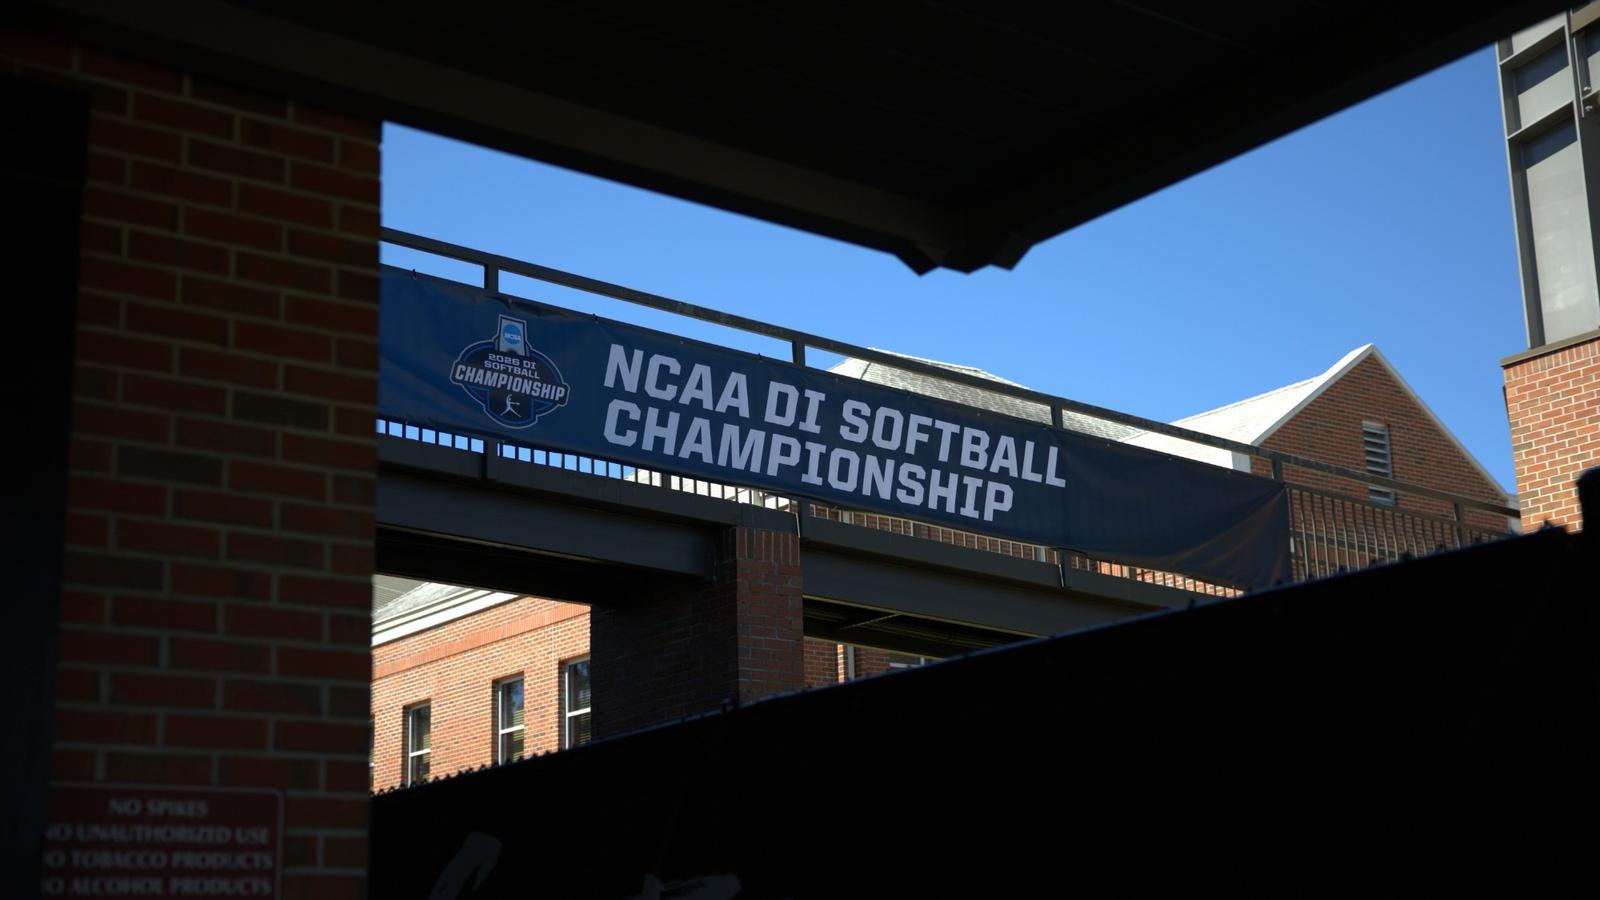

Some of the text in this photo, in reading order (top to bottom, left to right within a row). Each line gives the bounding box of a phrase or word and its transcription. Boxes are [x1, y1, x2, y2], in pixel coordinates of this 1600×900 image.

[484, 360, 540, 379] SOFTBALL
[489, 353, 537, 370] 2026 DI
[455, 365, 566, 401] CHAMPIONSHIP
[603, 343, 1066, 488] NCAA DI SOFTBALL
[603, 399, 1014, 521] CHAMPIONSHIP
[108, 798, 208, 817] NO SPIKES
[76, 824, 231, 843] UNAUTHORIZED
[235, 827, 268, 845] USE
[70, 851, 168, 869] TOBACCO
[170, 852, 273, 870] PRODUCTS
[69, 876, 163, 895] ALCOHOL
[169, 877, 272, 896] PRODUCTS
